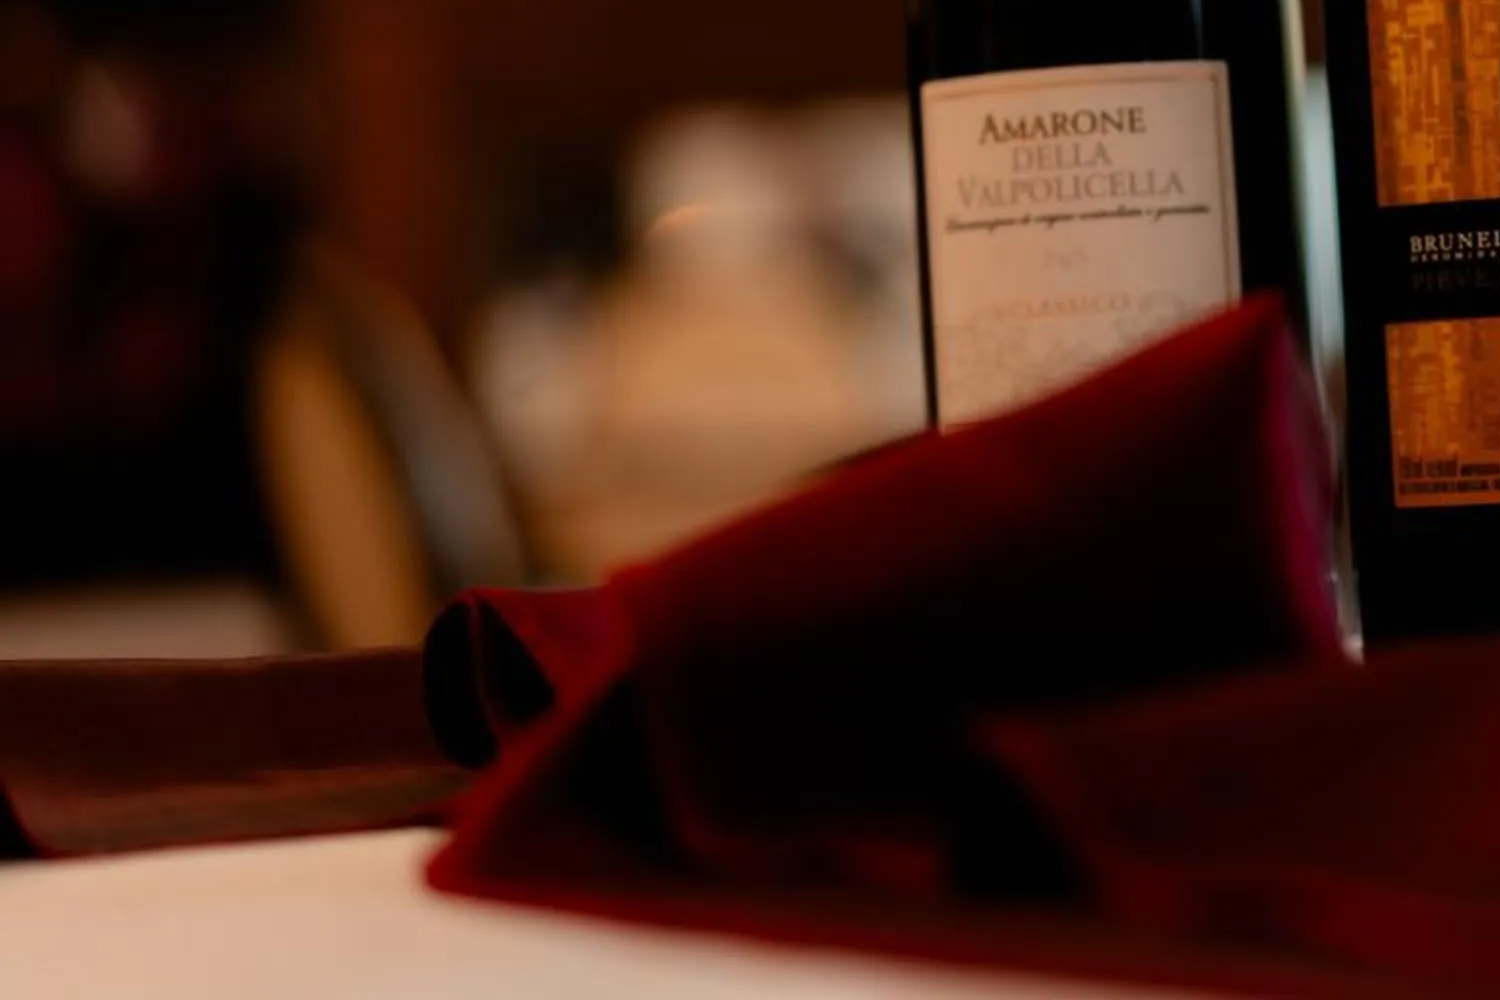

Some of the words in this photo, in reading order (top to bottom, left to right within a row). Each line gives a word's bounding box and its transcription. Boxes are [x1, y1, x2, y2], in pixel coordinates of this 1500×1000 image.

[978, 106, 1147, 146] AMARONE
[1011, 141, 1113, 173] DELLA
[957, 168, 1186, 209] VALPOLICELLA
